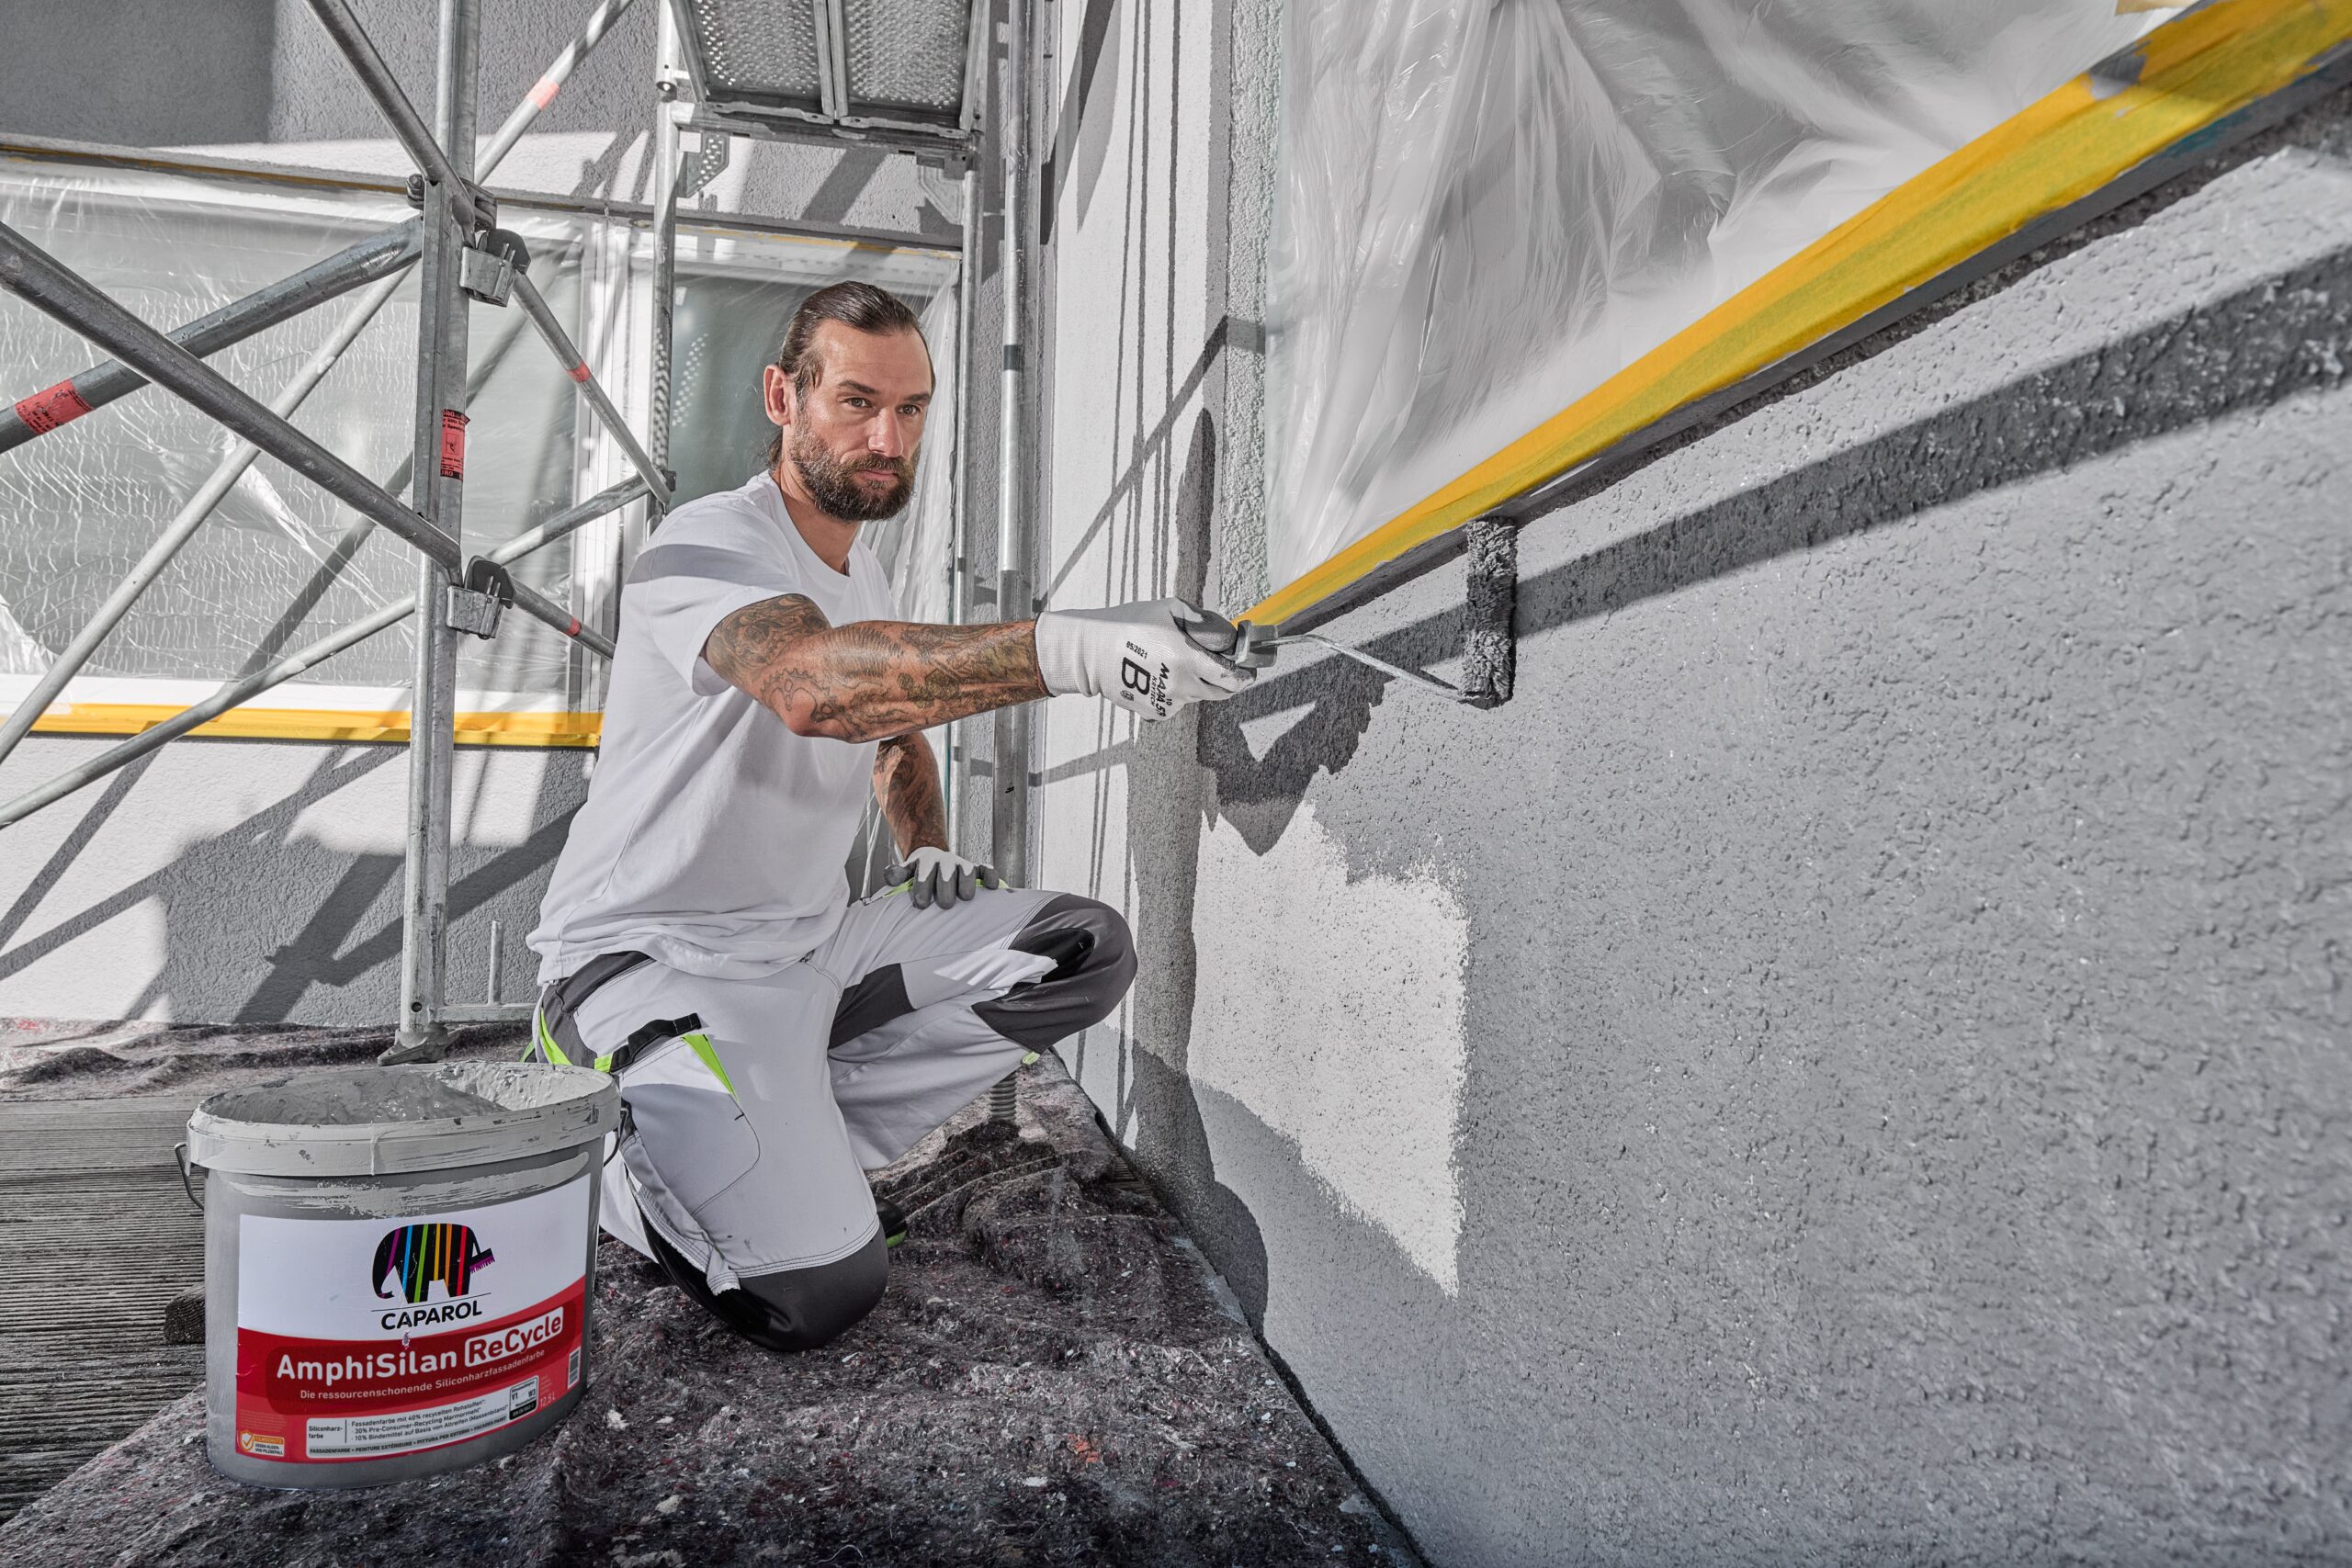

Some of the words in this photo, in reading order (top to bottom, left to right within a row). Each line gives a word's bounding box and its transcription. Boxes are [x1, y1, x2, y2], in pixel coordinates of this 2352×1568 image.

[1126, 640, 1148, 660] 05/2021
[1121, 656, 1151, 696] B
[1156, 661, 1170, 703] MAPA
[1166, 698, 1172, 706] 10
[381, 1300, 482, 1330] CAPAROL
[277, 1349, 457, 1387] AmphiSilan
[469, 1315, 561, 1364] ReCycle
[300, 1390, 315, 1399] Die
[318, 1382, 433, 1399] ressourcenschonende
[435, 1348, 545, 1389] Siliconharzfassadenfarbe
[351, 1417, 396, 1427] Fassadenfarbe
[368, 1431, 403, 1440] Bindemittel
